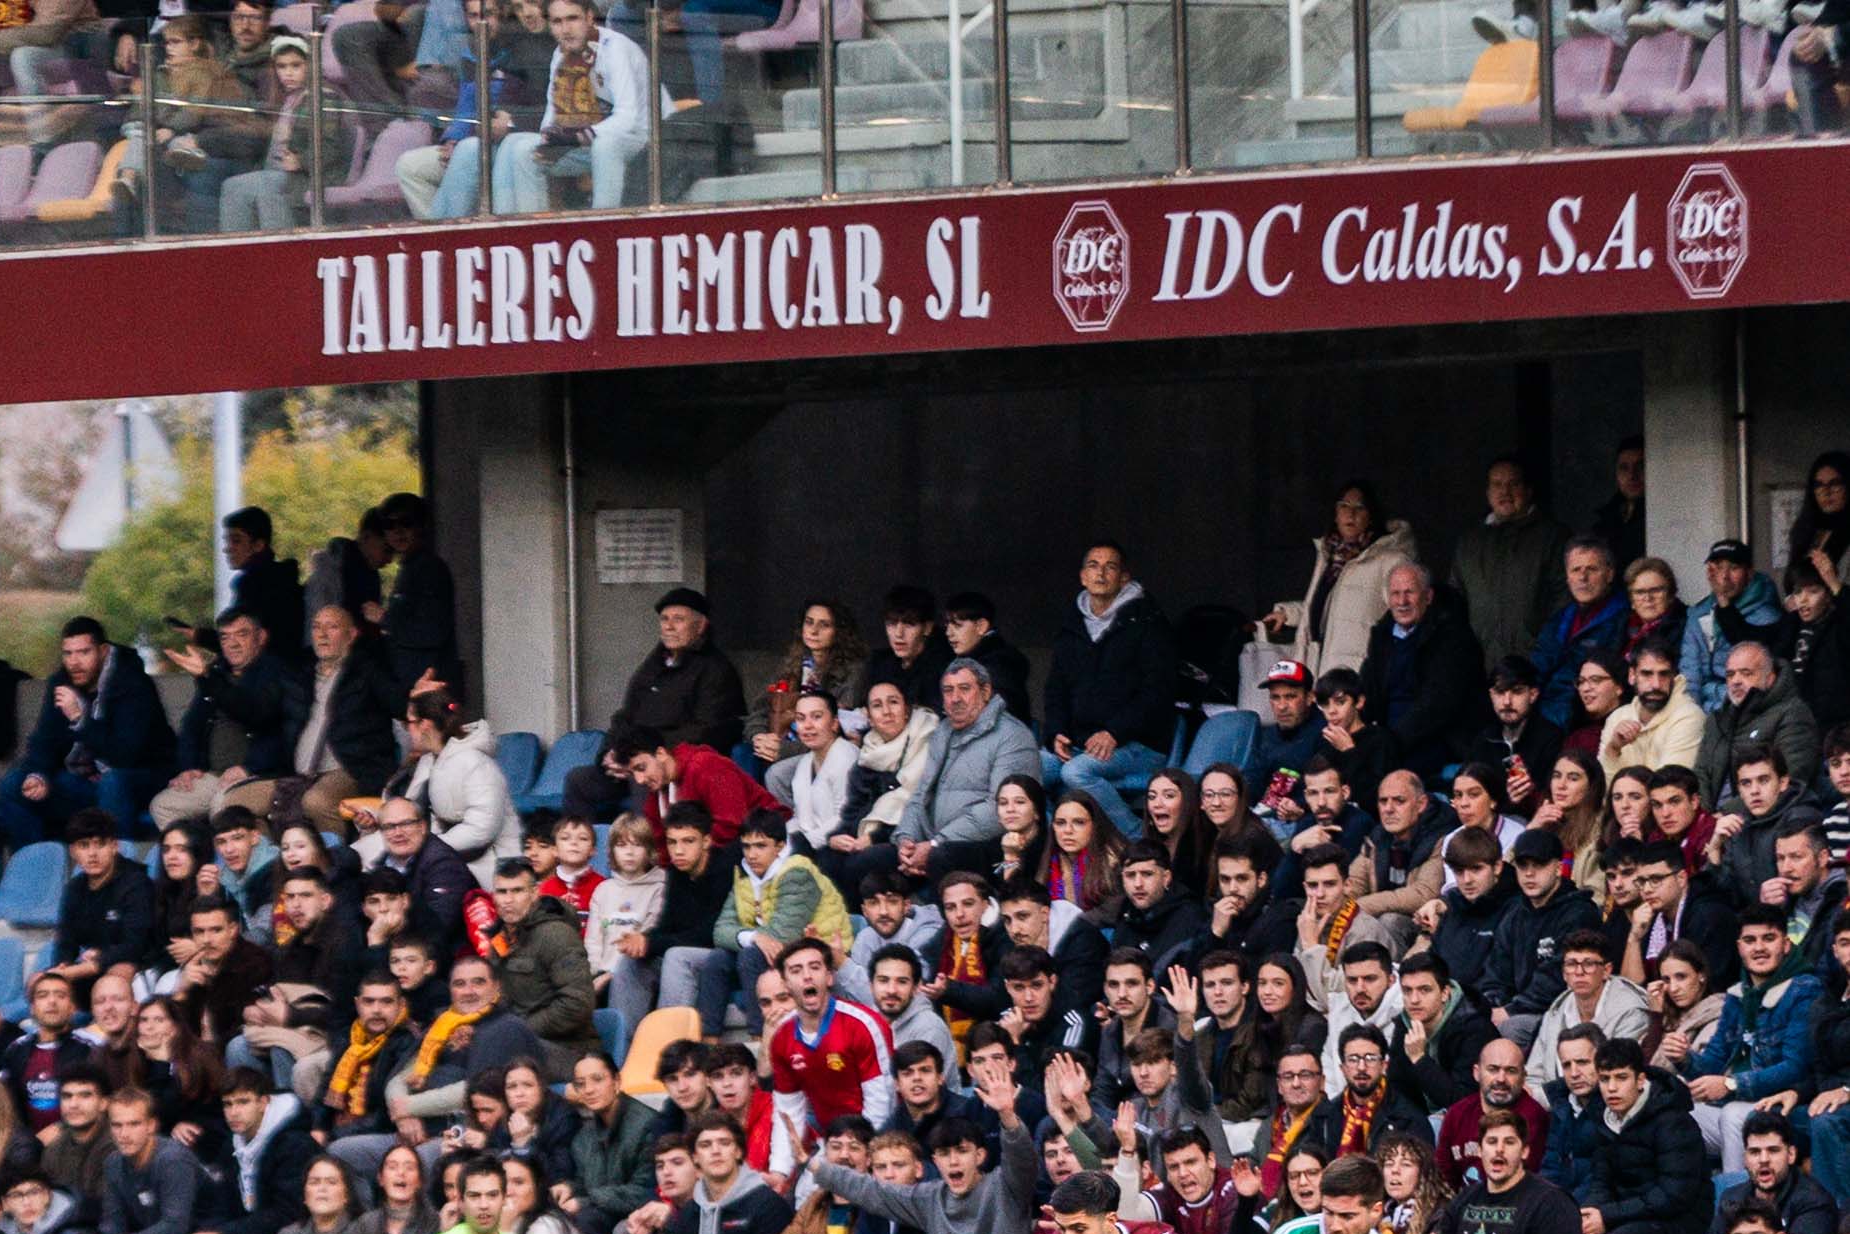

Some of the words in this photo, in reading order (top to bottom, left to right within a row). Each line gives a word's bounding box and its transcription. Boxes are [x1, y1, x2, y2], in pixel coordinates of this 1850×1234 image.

[316, 238, 596, 356] TALLERES
[615, 222, 903, 336] HEMICAR,
[926, 216, 991, 320] SL
[1151, 203, 1304, 303] IDC
[1320, 200, 1522, 293] Caldas,
[1537, 192, 1655, 276] S.A.
